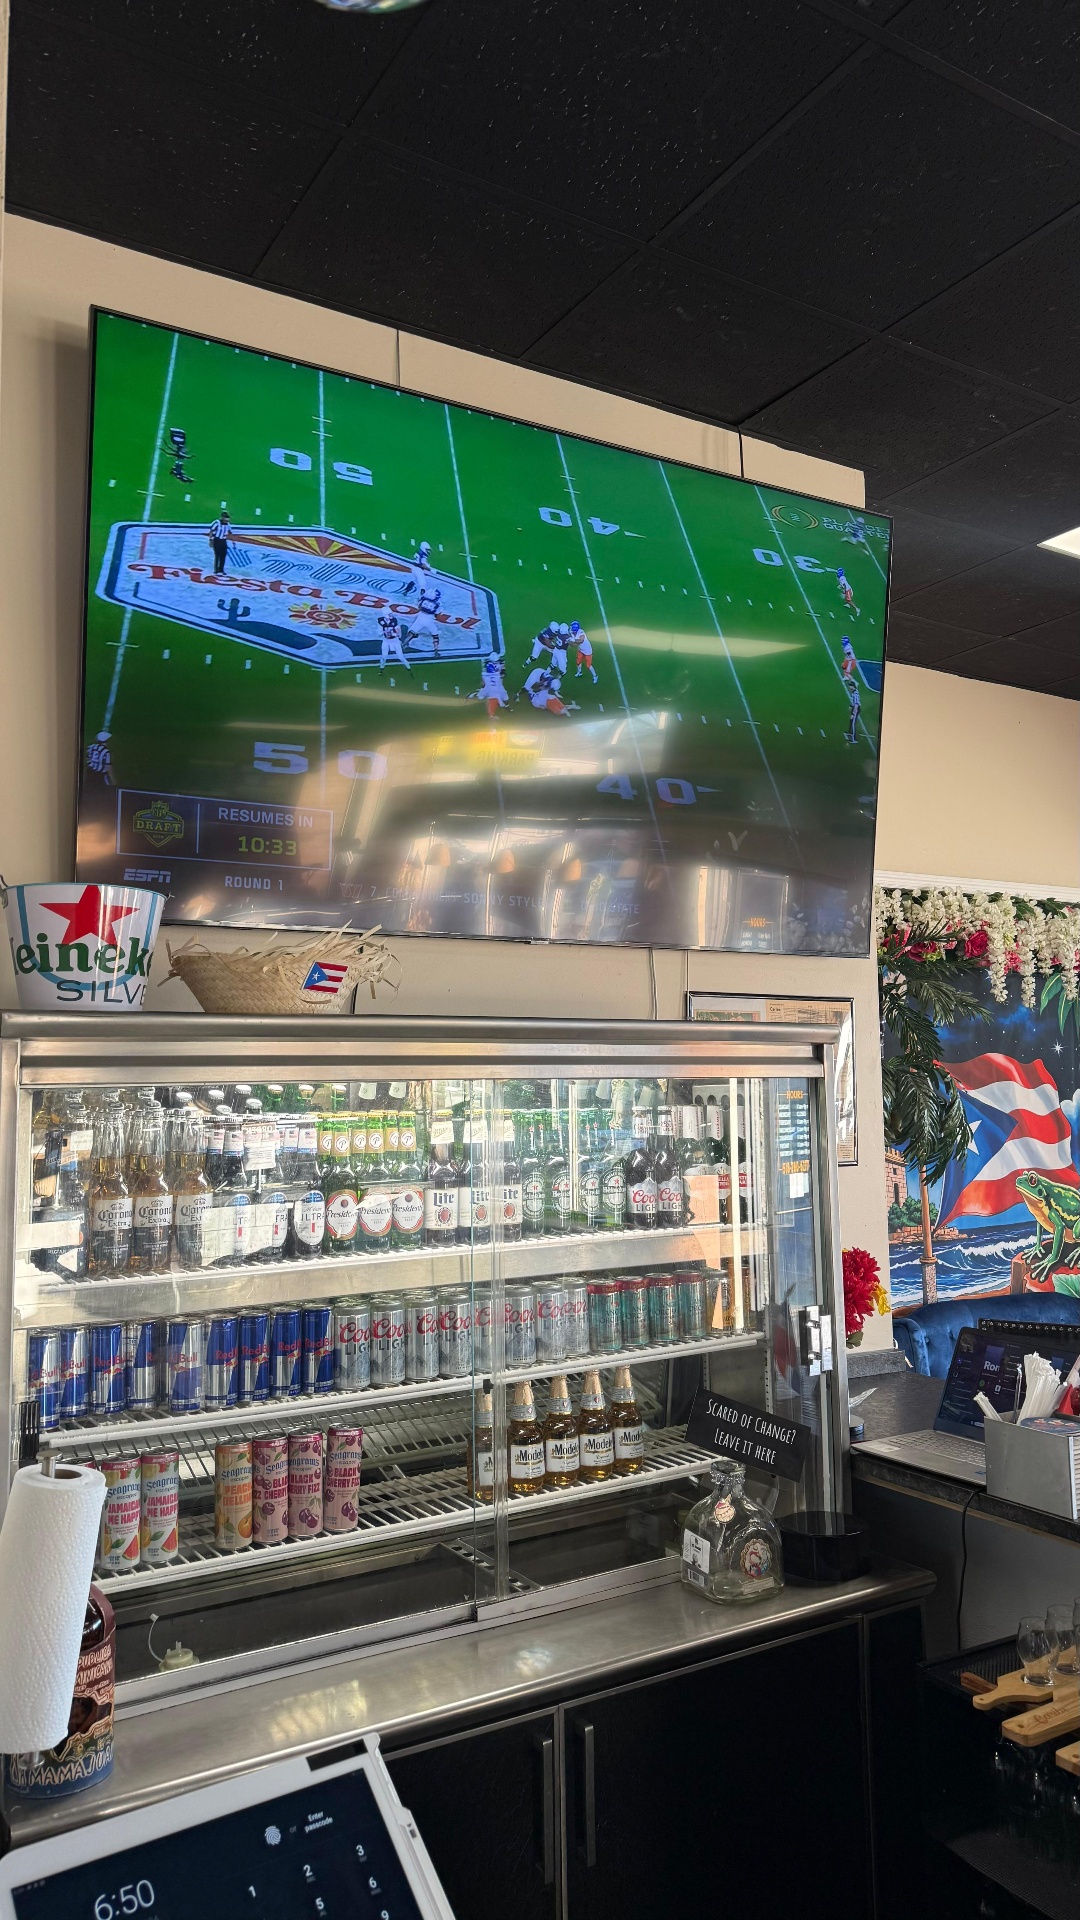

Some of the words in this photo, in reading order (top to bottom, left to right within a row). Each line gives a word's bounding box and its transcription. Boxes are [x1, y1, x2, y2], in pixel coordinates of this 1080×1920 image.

[128, 563, 323, 600] Fiesta
[218, 807, 294, 827] RESUMES
[298, 815, 313, 828] IN
[136, 820, 182, 834] DRAFT
[238, 836, 298, 857] 10:33
[124, 868, 171, 884] ESPN
[225, 875, 271, 890] ROUND
[278, 879, 283, 890] 1
[509, 895, 547, 909] STYLE
[11, 932, 153, 976] einek
[56, 979, 147, 1005] SILV
[433, 1192, 454, 1206] Lite
[633, 1190, 656, 1203] Coo
[659, 1188, 682, 1202] Coo
[636, 1204, 656, 1212] LIGH
[662, 1202, 683, 1211] LIGH
[441, 1311, 472, 1330] Coo
[339, 1322, 371, 1343] Coo
[373, 1318, 405, 1338] Coo
[445, 1330, 472, 1342] LIGH
[242, 1344, 261, 1355] Red
[278, 1340, 296, 1351] Red
[305, 1338, 323, 1349] Red
[379, 1339, 406, 1351] LIGH
[179, 1353, 198, 1364] Bull
[215, 1349, 232, 1360] Red
[70, 1357, 86, 1368] Bull
[40, 1367, 59, 1378] Bull
[706, 1399, 738, 1424] SCARED
[740, 1413, 753, 1429] OF
[755, 1417, 797, 1445] CHANGE?
[588, 1438, 612, 1450] Model
[714, 1428, 740, 1451] LEAVE
[742, 1440, 753, 1456] IT
[755, 1445, 777, 1465] HERE
[519, 1449, 543, 1462] Model
[334, 1468, 356, 1477] BLACK
[308, 1482, 320, 1493] FIZZ
[327, 1477, 351, 1488] CHERRY
[147, 1492, 178, 1507] JAMAICA
[108, 1500, 140, 1513] JAMAICA
[147, 1507, 158, 1518] ME
[160, 1504, 178, 1516] HAPP
[108, 1515, 119, 1525] ME
[120, 1511, 140, 1524] HAPP
[307, 1811, 324, 1822] Enter
[304, 1816, 333, 1833] passcode
[356, 1844, 365, 1856] 3
[303, 1864, 313, 1876] 2
[368, 1876, 377, 1889] 6
[248, 1885, 256, 1898] 1
[94, 1879, 156, 1920] 6:50
[315, 1897, 324, 1910] 5
